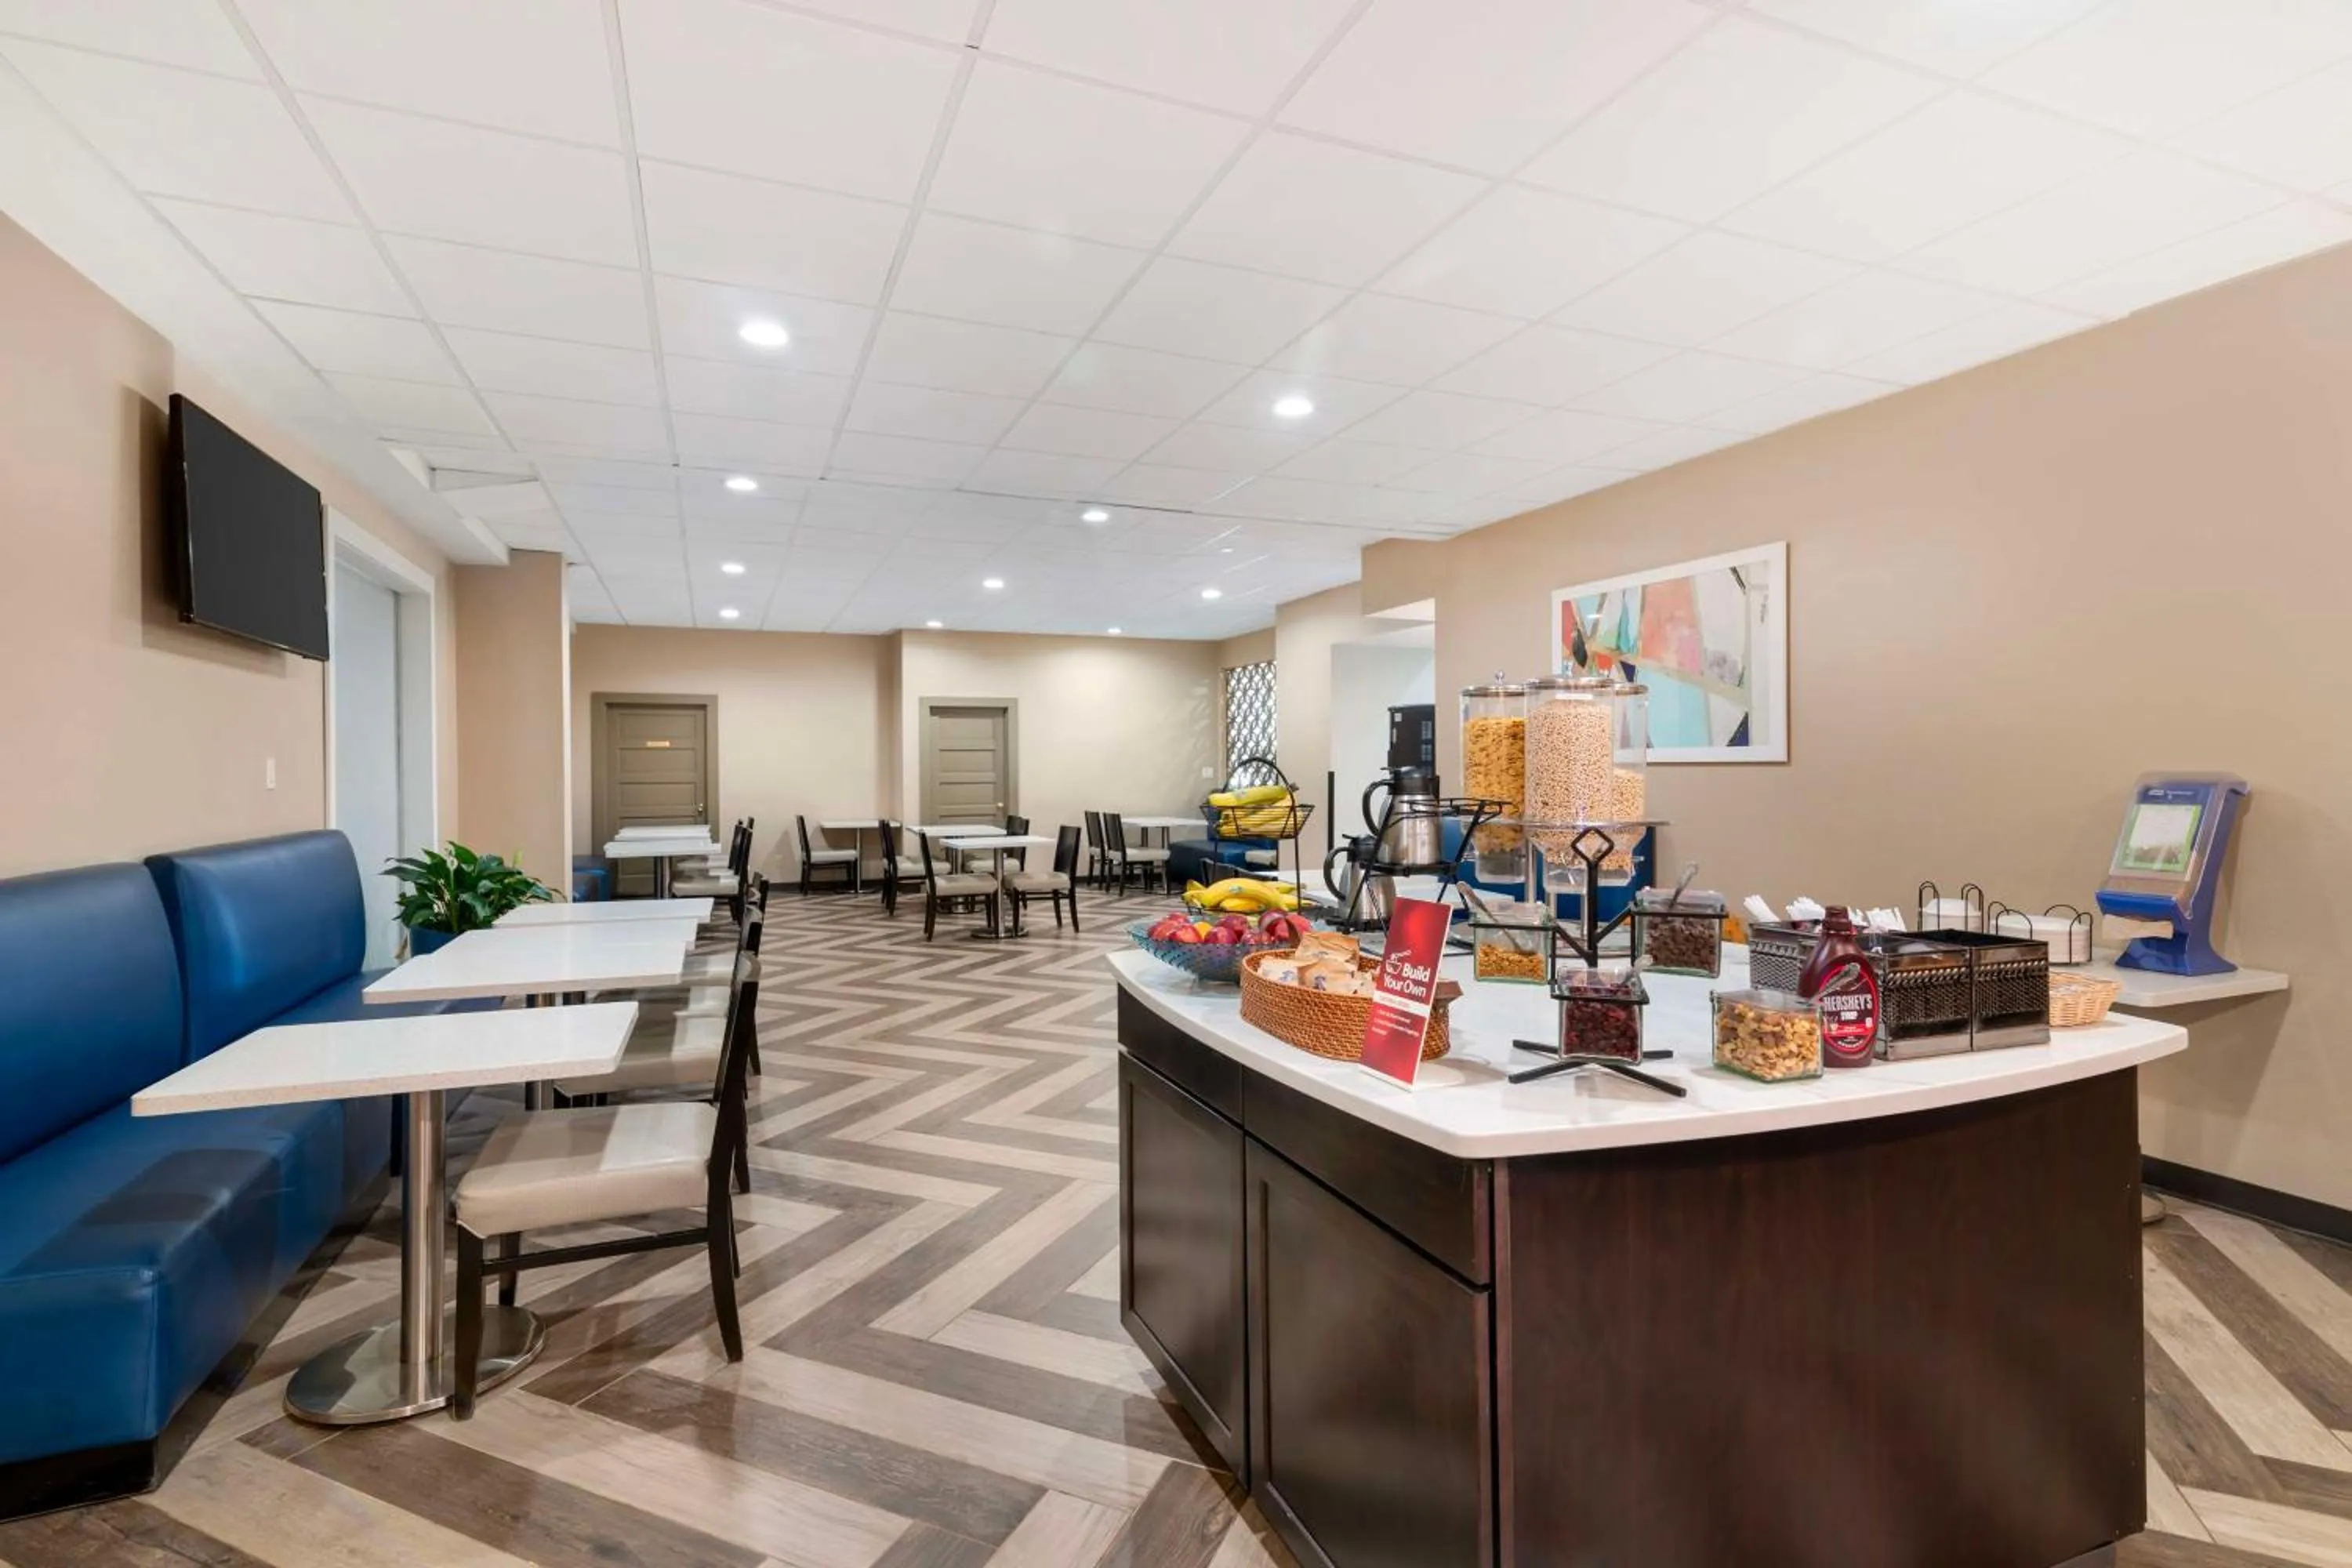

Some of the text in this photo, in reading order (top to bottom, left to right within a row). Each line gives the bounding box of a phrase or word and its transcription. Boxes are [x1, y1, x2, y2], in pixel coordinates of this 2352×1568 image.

[1403, 963, 1430, 982] Build
[1384, 973, 1426, 997] Your Own
[1823, 993, 1872, 1011] HERSHEY'S
